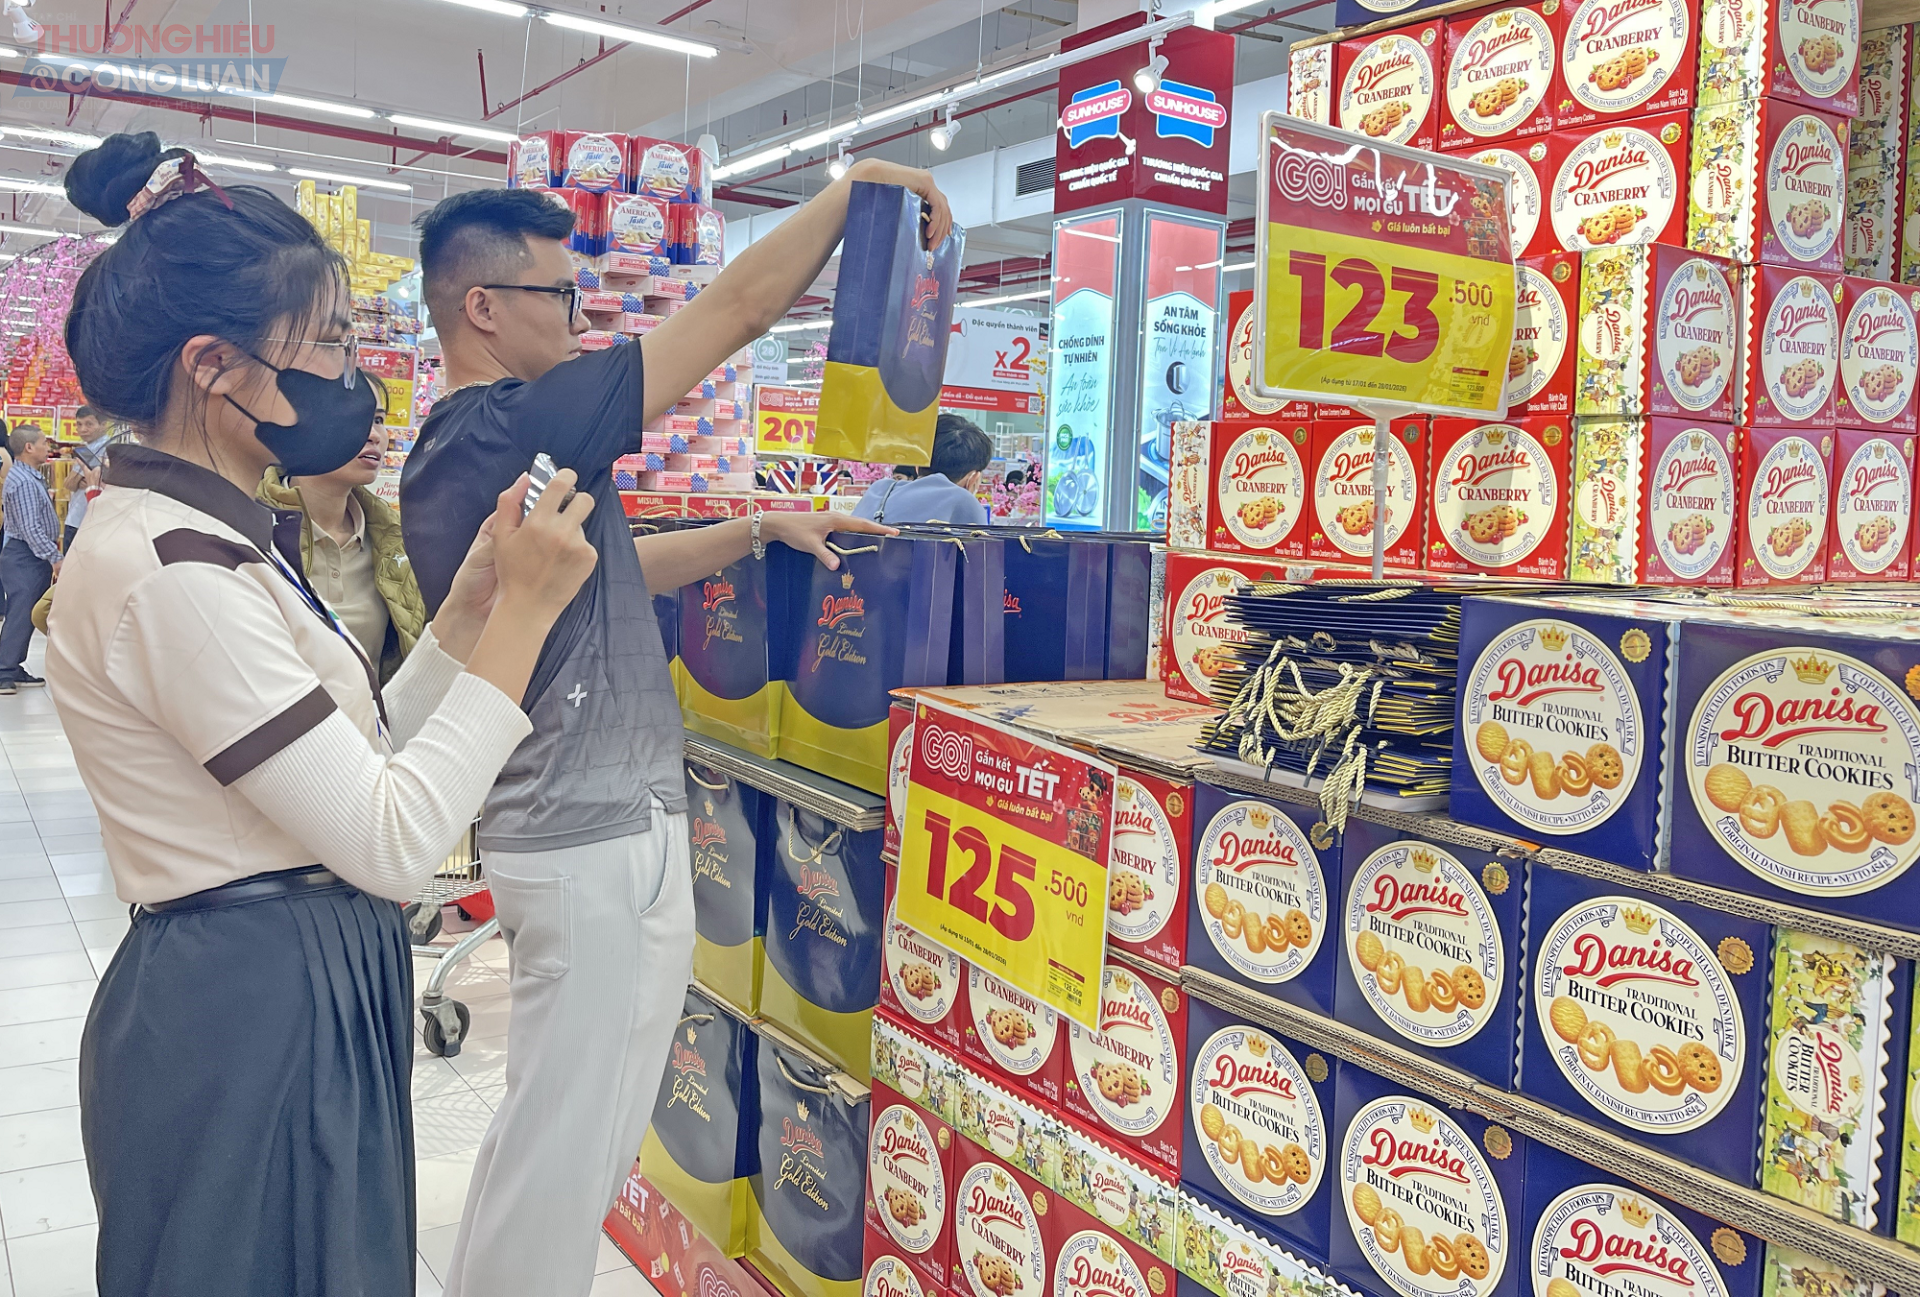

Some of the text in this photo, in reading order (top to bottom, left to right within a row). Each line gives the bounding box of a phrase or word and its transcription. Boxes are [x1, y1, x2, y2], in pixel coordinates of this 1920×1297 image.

[1463, 26, 1534, 70] Danisa
[1466, 59, 1533, 83] CRANBERRY
[1067, 97, 1124, 122] SUNHOUSE
[1153, 96, 1219, 121] SUNHOUSE
[577, 142, 614, 153] AMERICAN
[1210, 172, 1224, 181] GIA
[1275, 150, 1348, 211] GO!
[1351, 171, 1375, 190] Gắn
[1569, 147, 1650, 193] Danisa
[620, 205, 657, 218] AMERICAN
[1353, 195, 1381, 215] MỌI
[1383, 200, 1404, 216] GU
[1574, 185, 1651, 208] CRANBERRY
[1387, 221, 1451, 237] Giá luôn bất bại
[1163, 305, 1199, 321] AN TÂM
[1289, 250, 1493, 363] 123 .500
[1472, 315, 1490, 327] vnd
[1670, 284, 1723, 329] Danisa
[972, 318, 1038, 333] Đặc quyền thành viên
[1058, 334, 1105, 349] CHỐNG DÍNH
[1154, 319, 1179, 334] SỐNG
[1674, 323, 1723, 345] CRANBERRY
[364, 353, 388, 366] TẾT
[994, 336, 1031, 371] x2
[1063, 351, 1098, 366] TỰ NHIÊN
[1452, 444, 1531, 485] Danisa
[376, 487, 400, 498] Delig
[637, 497, 664, 505] MISURA
[705, 499, 731, 507] MISURA
[770, 501, 795, 509] MISURA
[834, 501, 857, 510] UNIBI
[1458, 486, 1531, 503] CRANBERRY
[817, 590, 865, 628] Danisa
[836, 622, 864, 638] Limited
[811, 634, 867, 673] Gold Edition
[1488, 653, 1605, 706] Danisa
[1542, 702, 1604, 724] TRADITIONAL
[1720, 687, 1888, 749] Danisa
[1852, 672, 1912, 735] COPENHAGEN
[1492, 704, 1609, 742] BUTTER COOKIES
[922, 724, 973, 782] GO!
[975, 750, 1012, 773] Gắn kết
[1727, 744, 1894, 791] BUTTER COOKIES
[1797, 743, 1887, 769] TRADITIONAL
[974, 759, 1061, 800] MỌI GU TẾT
[997, 798, 1053, 823] Giá luôn bất bại
[1722, 825, 1890, 885] ORIGINAL DANISH RECIPE NETTO 454g
[797, 865, 840, 900] Danisa
[924, 810, 1088, 942] 125 .500
[817, 897, 844, 919] Limited
[1366, 874, 1469, 921] Danisa
[789, 902, 848, 947] Gold Edition
[1066, 911, 1084, 927] vnd
[1412, 919, 1468, 947] TRADITIONAL
[1369, 915, 1473, 965] BUTTER COOKIES
[1563, 934, 1700, 989] Danisa
[1567, 979, 1705, 1042] BUTTER COOKIES
[1626, 986, 1699, 1021] TRADITIONAL
[1786, 1035, 1800, 1093] COOKIES
[1798, 1044, 1813, 1094] BUTTER
[1816, 1031, 1842, 1116] Danisa
[1812, 1066, 1820, 1109] TRADITIONAL
[780, 1117, 824, 1158] Danisa
[800, 1155, 827, 1181] Limited
[1362, 1127, 1471, 1185] Danisa
[774, 1153, 830, 1212] Gold Edition
[1412, 1178, 1470, 1215] TRADITIONAL
[967, 1186, 1026, 1229] Danisa
[1366, 1167, 1476, 1234] BUTTER COOKIES
[632, 1211, 645, 1235] bại
[970, 1216, 1027, 1267] CRANBERRY
